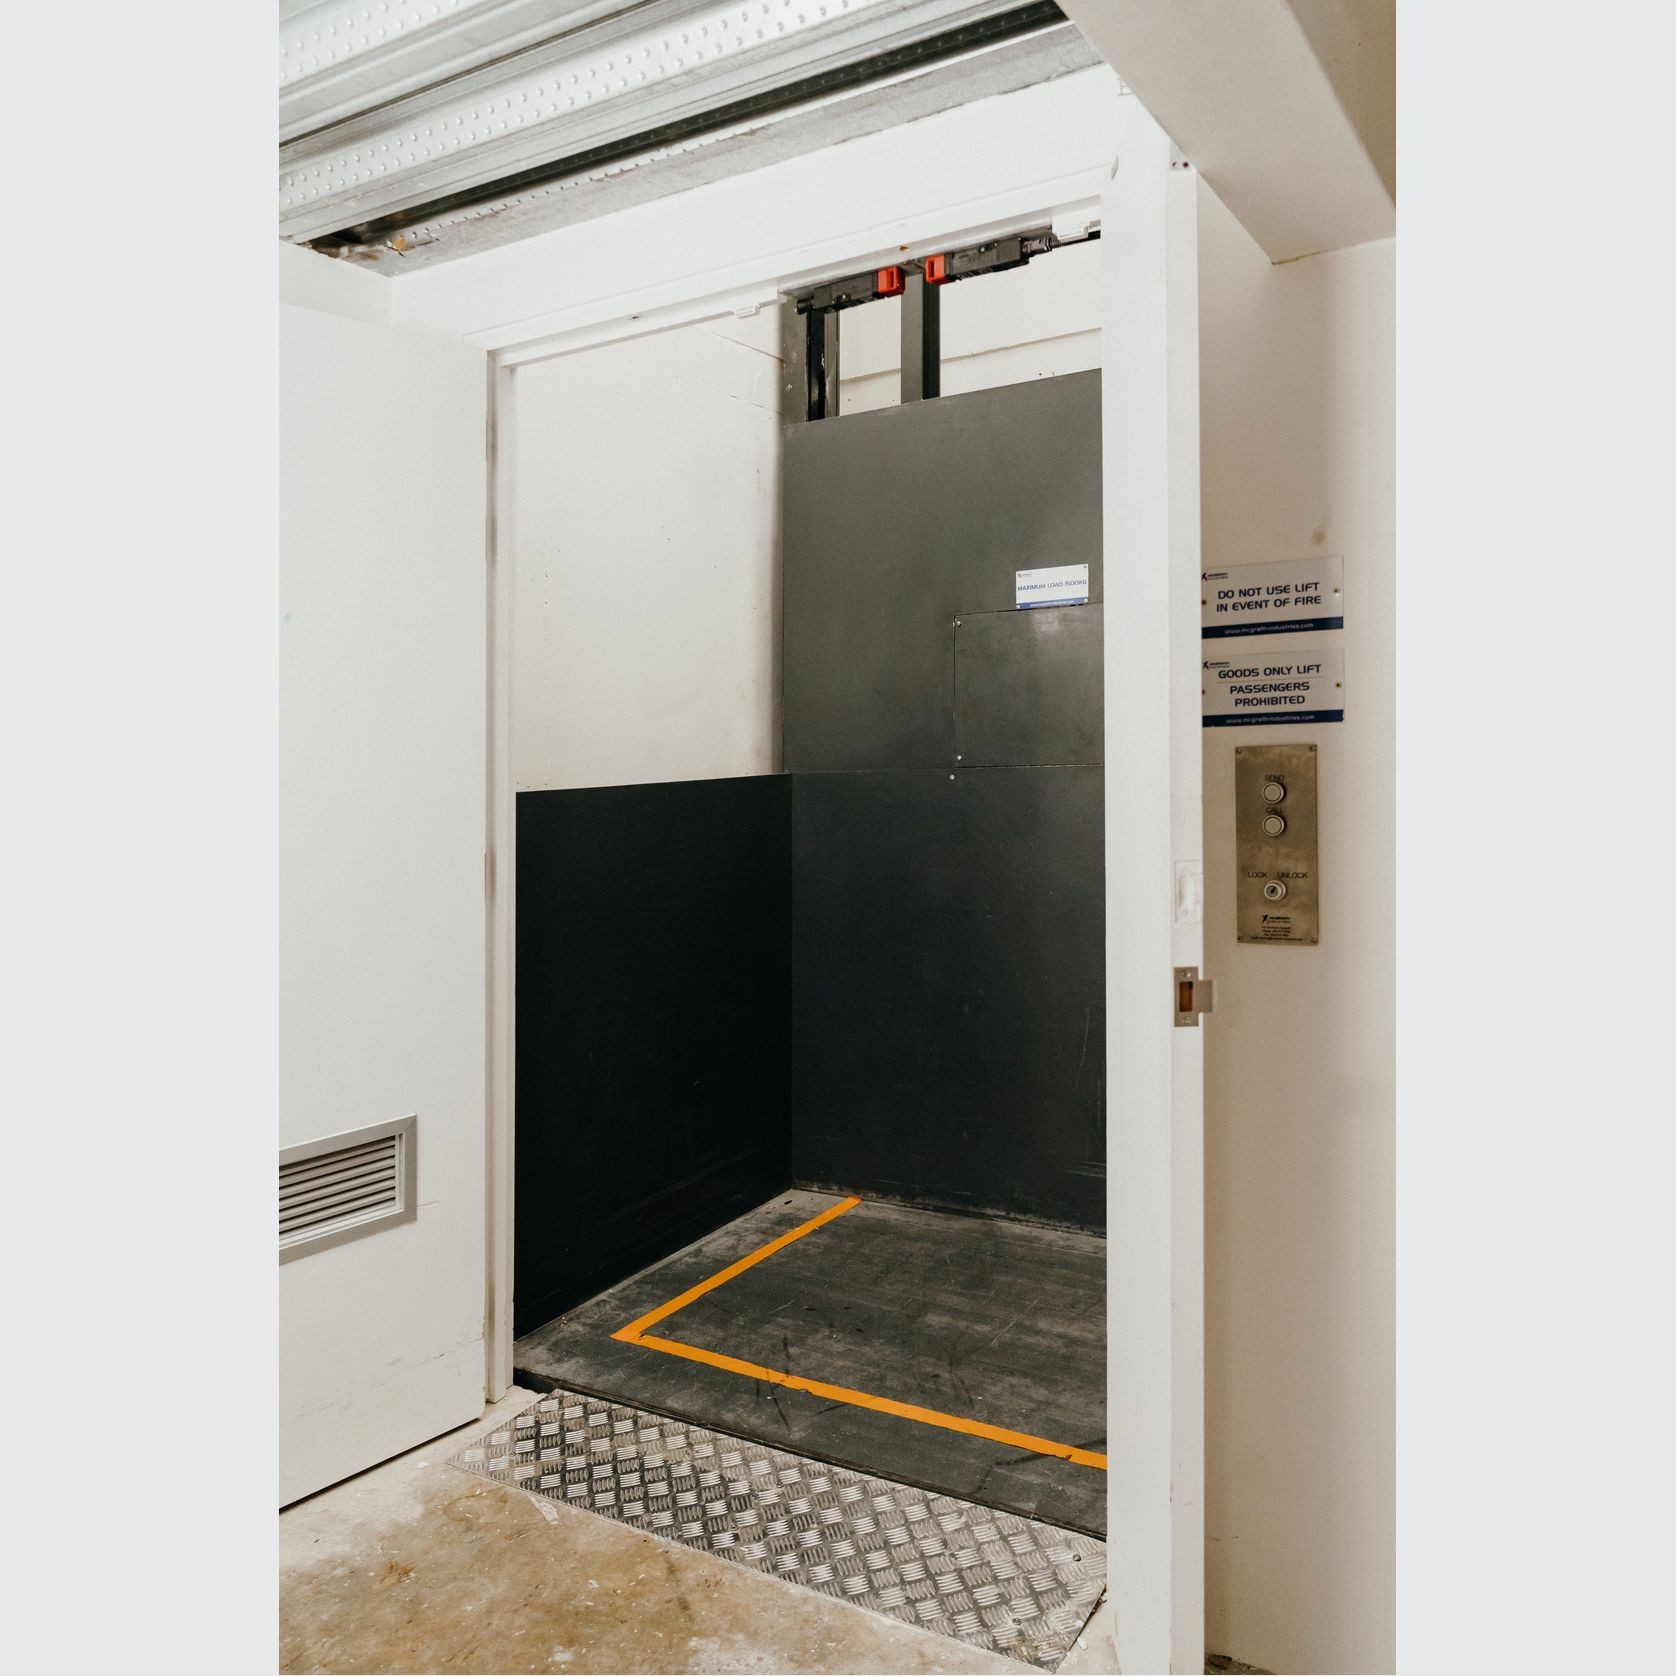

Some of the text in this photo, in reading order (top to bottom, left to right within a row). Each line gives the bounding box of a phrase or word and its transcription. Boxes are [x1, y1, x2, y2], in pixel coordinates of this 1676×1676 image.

[1017, 583, 1046, 591] MAXIMUM
[1218, 582, 1320, 600] DO NOT USE LIFT
[1216, 595, 1321, 612] IN EVENT OF FIRE
[1218, 664, 1321, 679] GOODS ONLY LIFT
[1230, 682, 1310, 694] PASSENGERS
[1234, 695, 1305, 707] PROHIBITED
[1248, 871, 1308, 879] LOCK UNLOCK
